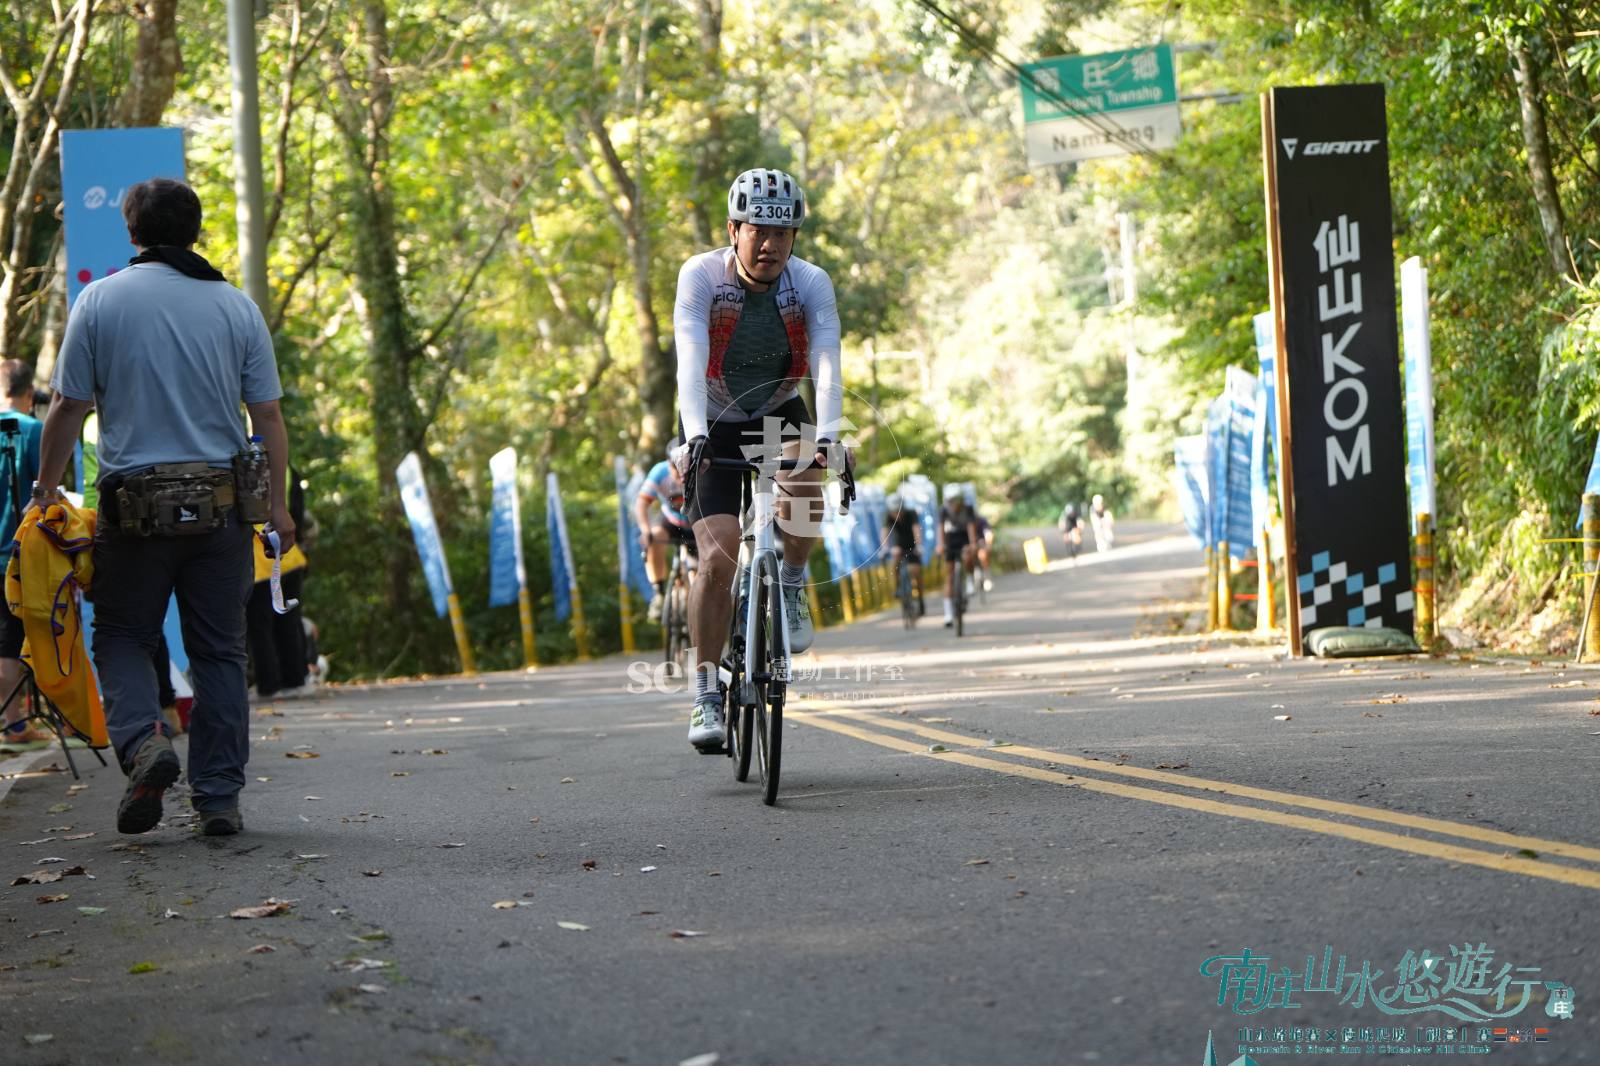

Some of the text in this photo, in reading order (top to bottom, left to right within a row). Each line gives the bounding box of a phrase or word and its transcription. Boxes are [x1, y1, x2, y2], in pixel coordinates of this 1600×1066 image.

[1106, 86, 1162, 105] Township
[1303, 140, 1379, 156] GIANT
[754, 205, 791, 219] 2304
